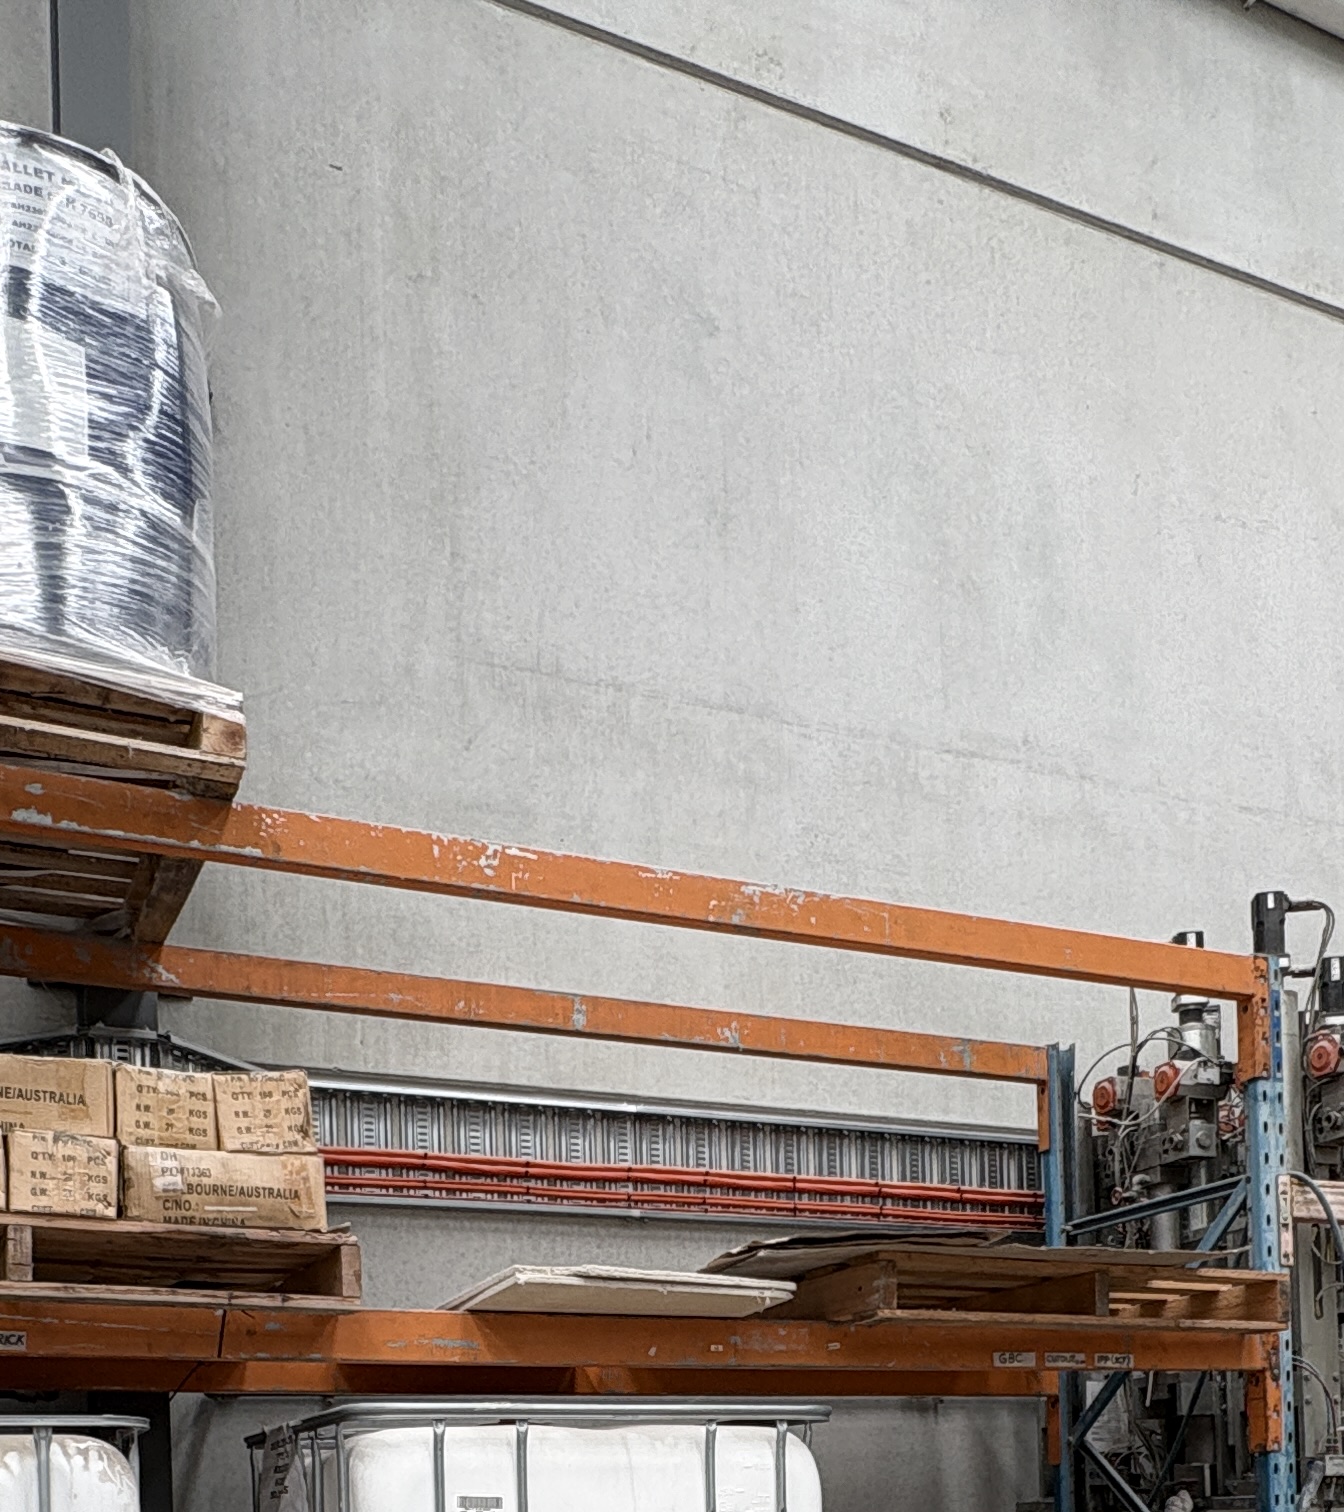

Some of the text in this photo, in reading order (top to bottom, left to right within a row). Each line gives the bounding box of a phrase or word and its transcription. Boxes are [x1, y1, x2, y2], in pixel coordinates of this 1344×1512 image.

[189, 1109, 207, 1119] KGS
[189, 1127, 207, 1137] KGS
[87, 1174, 108, 1184] KGS
[999, 1353, 1023, 1364] GBC
